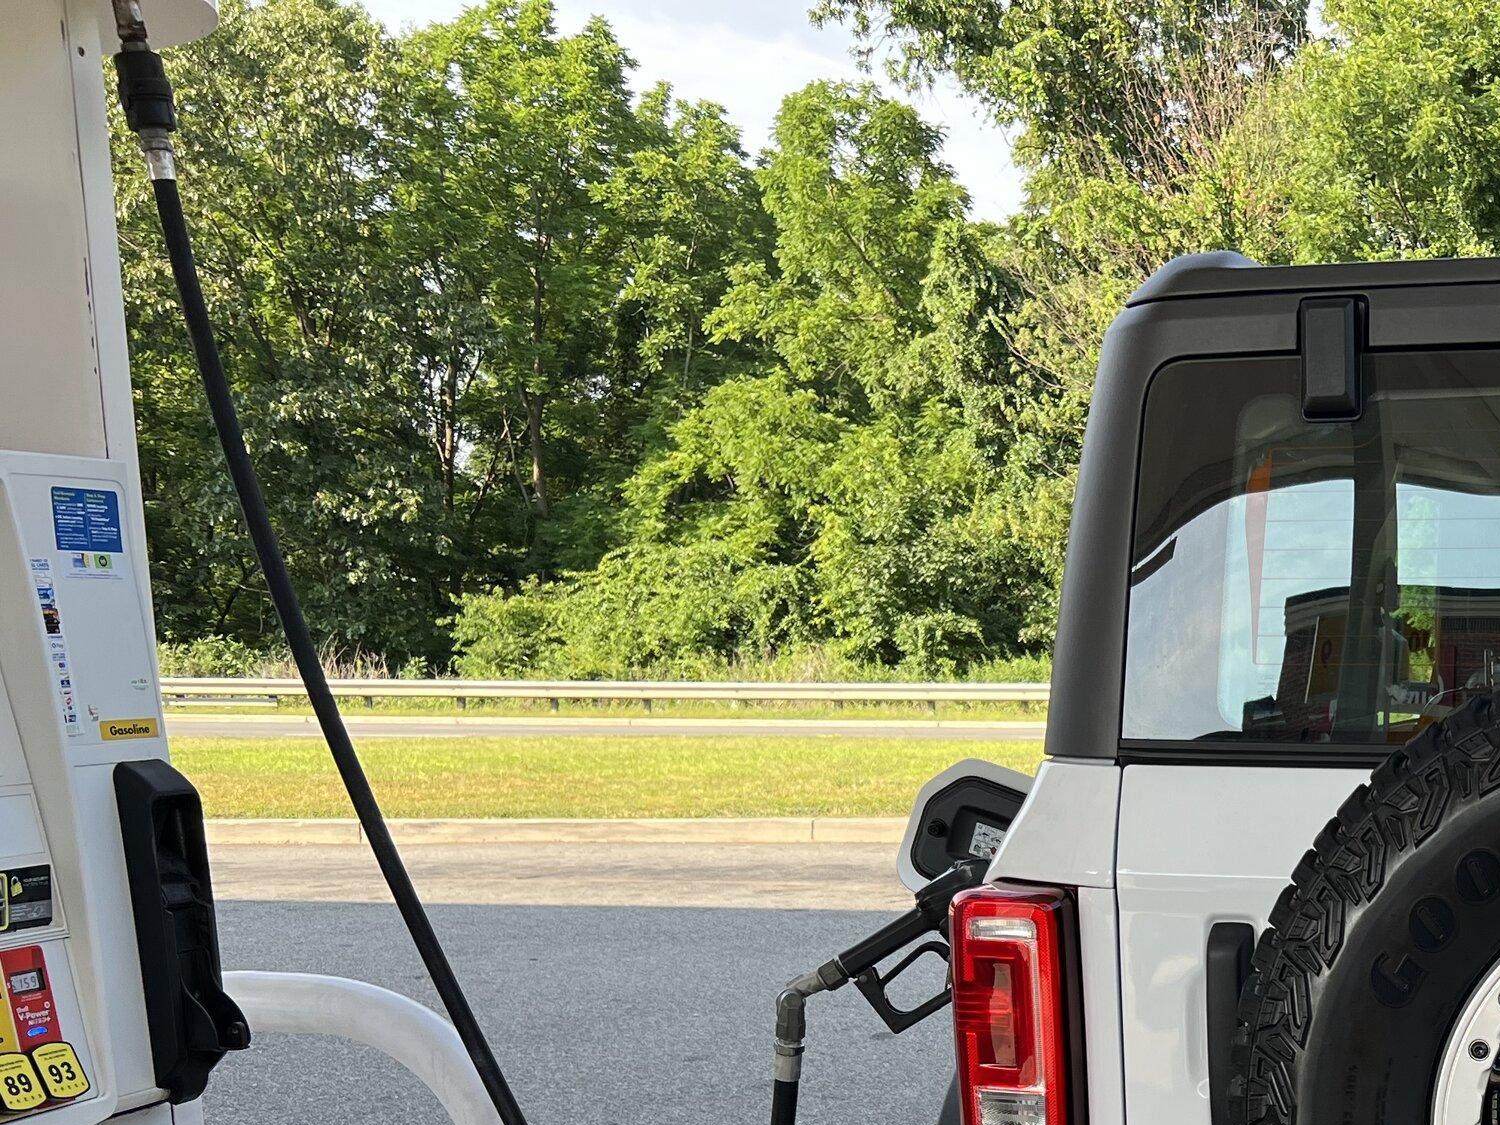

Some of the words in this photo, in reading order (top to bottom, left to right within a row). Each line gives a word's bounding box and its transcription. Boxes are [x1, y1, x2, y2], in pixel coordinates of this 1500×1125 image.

[109, 723, 151, 736] Gasoline
[48, 1061, 77, 1084] 93
[4, 1073, 33, 1096] 89
